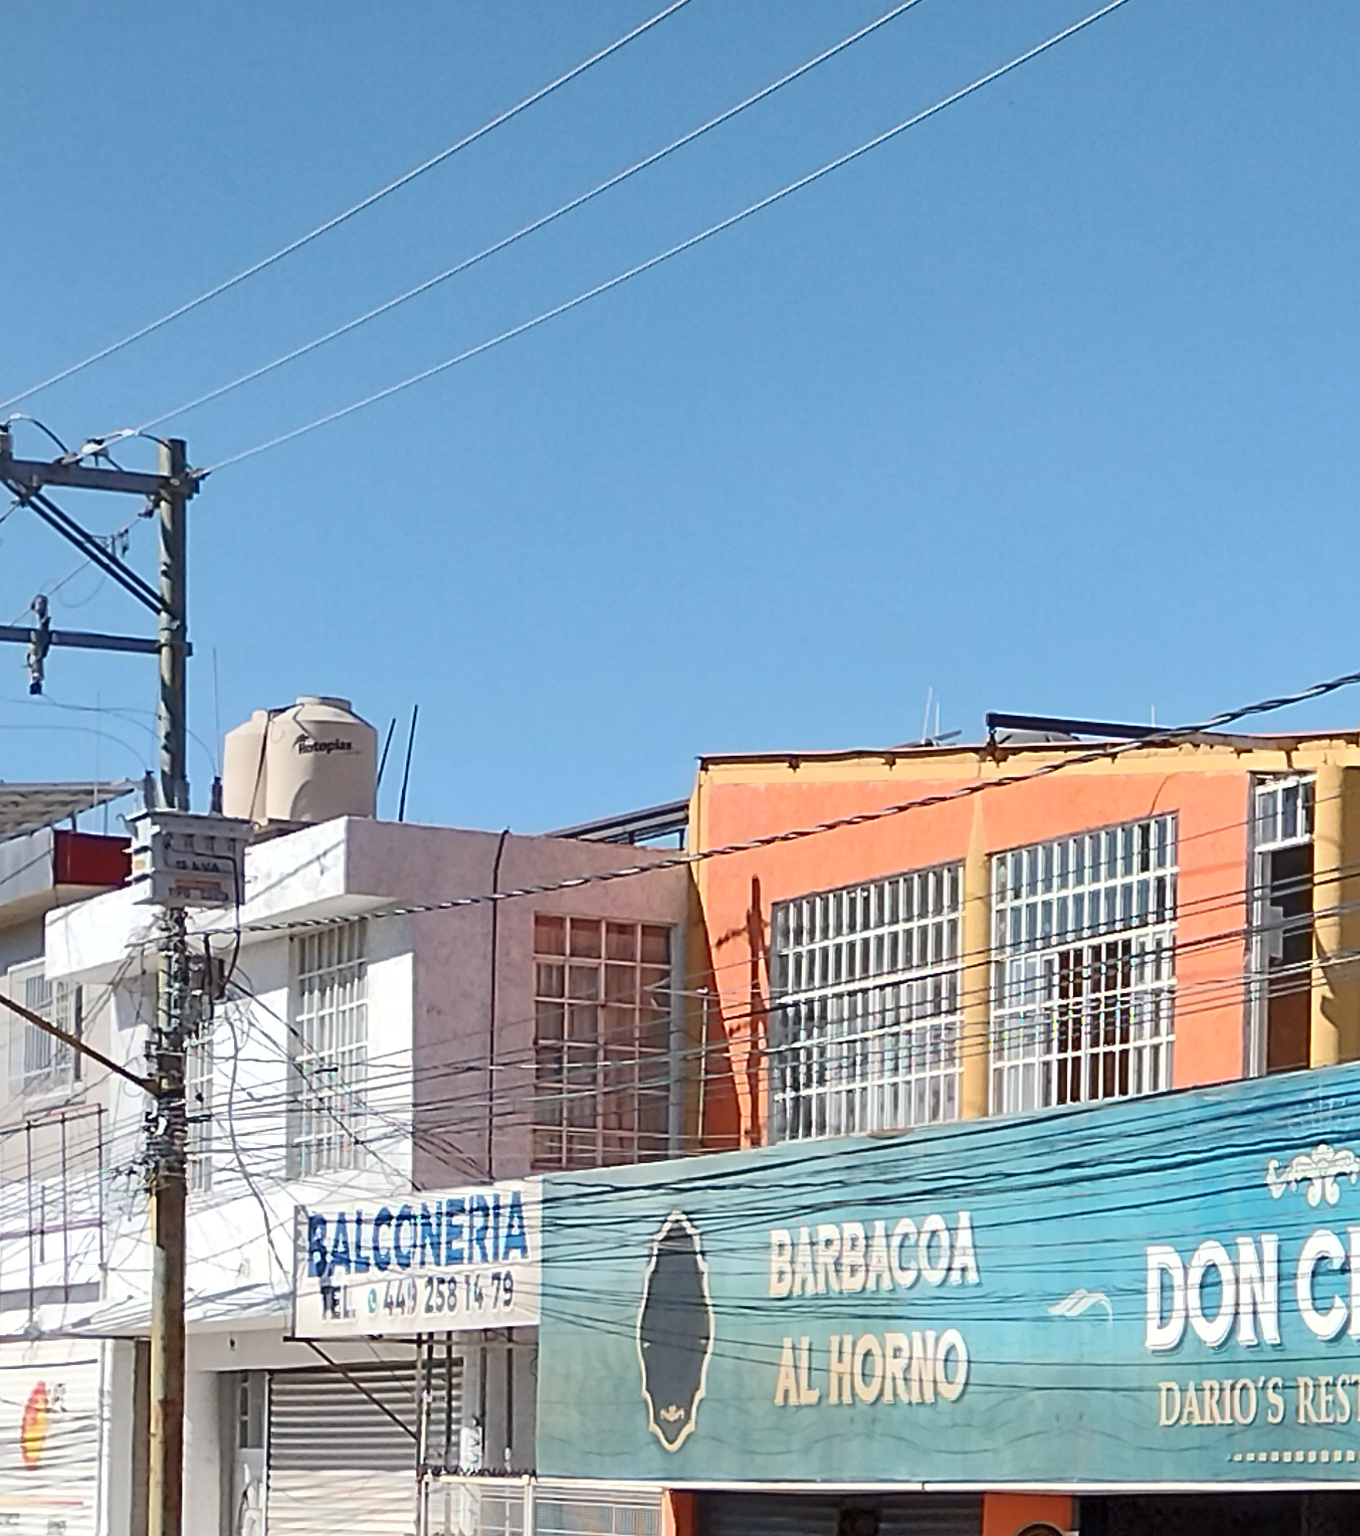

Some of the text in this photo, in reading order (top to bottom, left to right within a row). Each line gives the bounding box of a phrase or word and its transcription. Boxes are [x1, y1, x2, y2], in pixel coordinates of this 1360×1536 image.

[307, 1189, 529, 1279] BALCONERIA
[769, 1210, 981, 1298] BARBACOA
[321, 1282, 357, 1321] TEL.
[424, 1273, 459, 1316] 258
[464, 1271, 484, 1312] 14
[490, 1269, 515, 1311] 79
[1144, 1232, 1285, 1358] DON
[774, 1328, 969, 1407] AL HORNO
